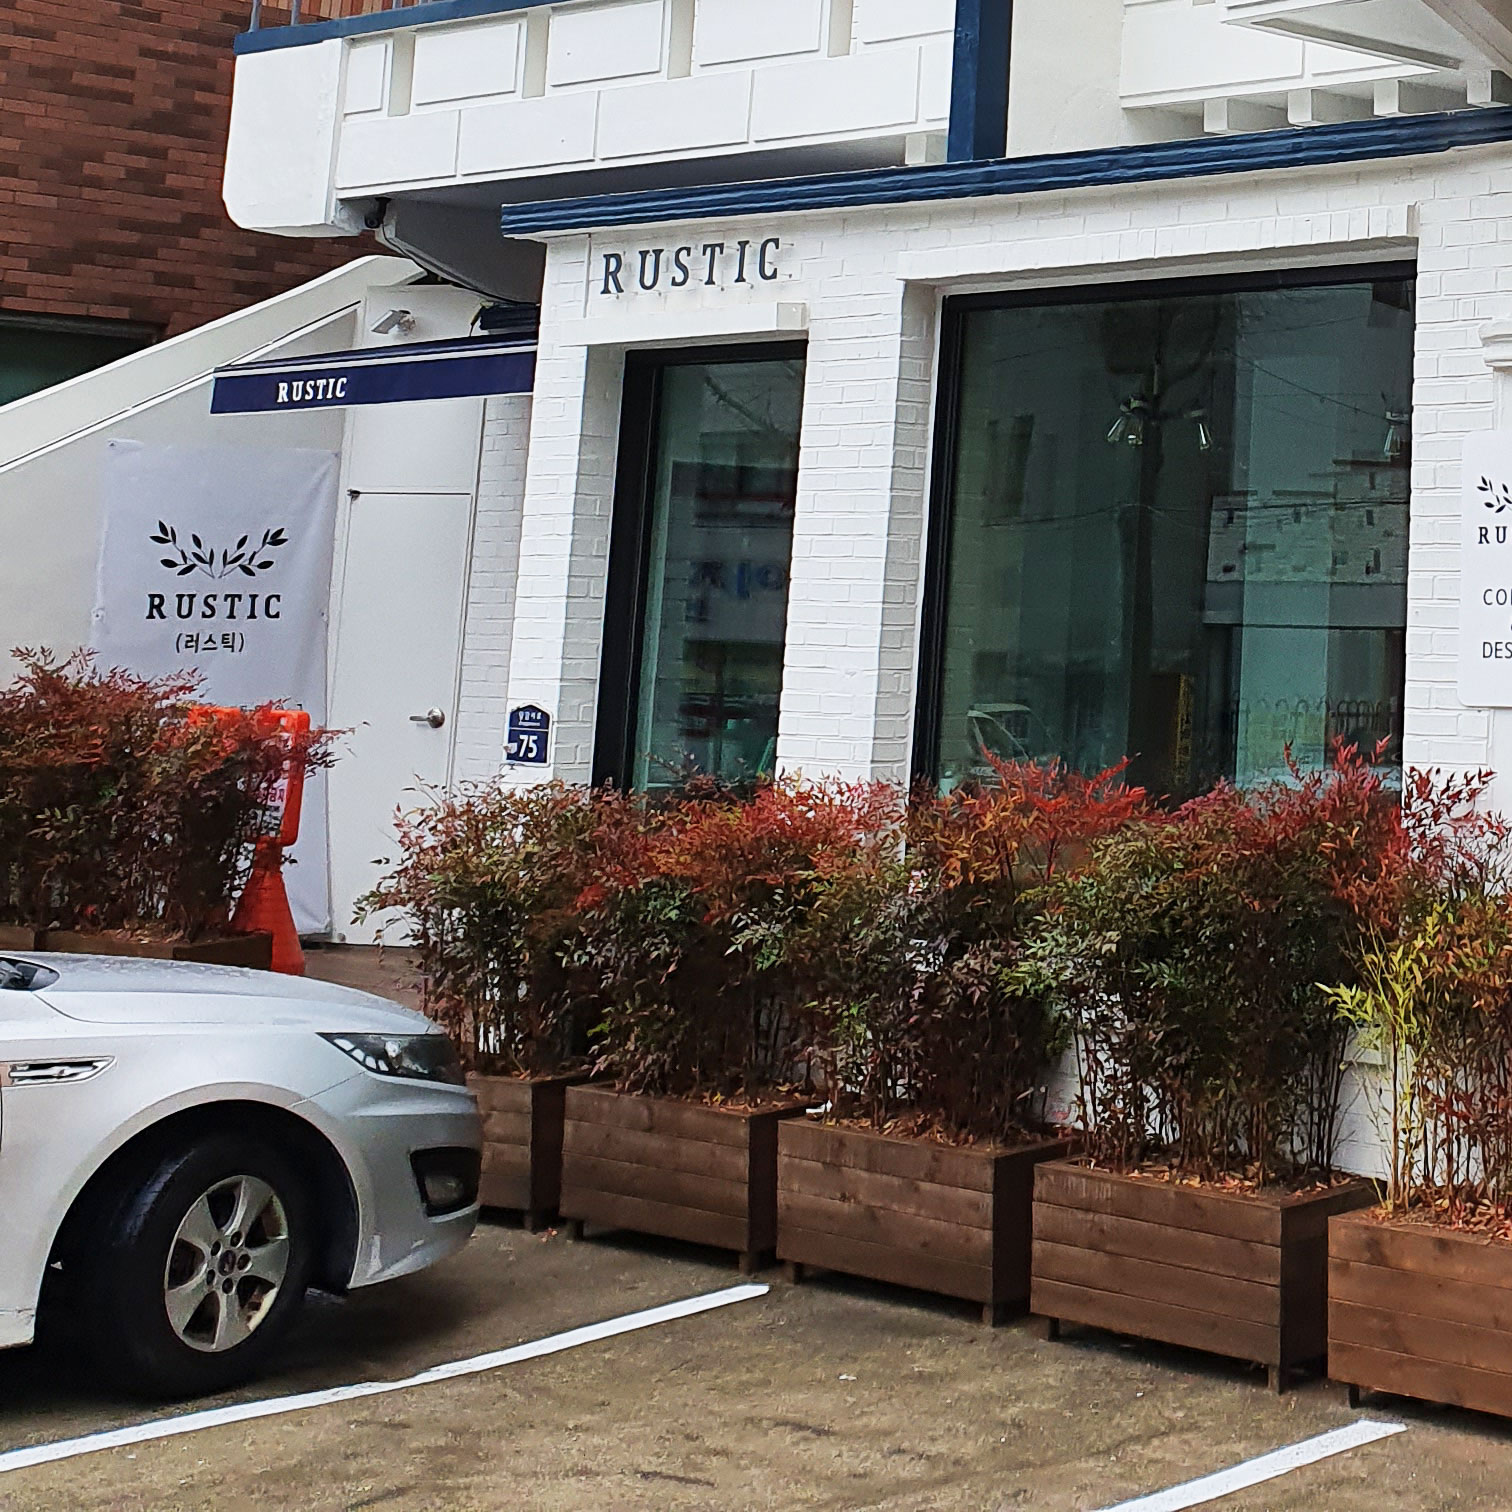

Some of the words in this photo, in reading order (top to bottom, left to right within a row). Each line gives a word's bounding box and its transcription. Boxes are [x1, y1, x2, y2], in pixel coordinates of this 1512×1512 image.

[600, 237, 780, 294] RUSTIC
[276, 377, 348, 403] RUSTIC
[146, 593, 281, 619] RUSTIC
[176, 632, 245, 653] (러스틱)
[518, 734, 538, 758] 75
